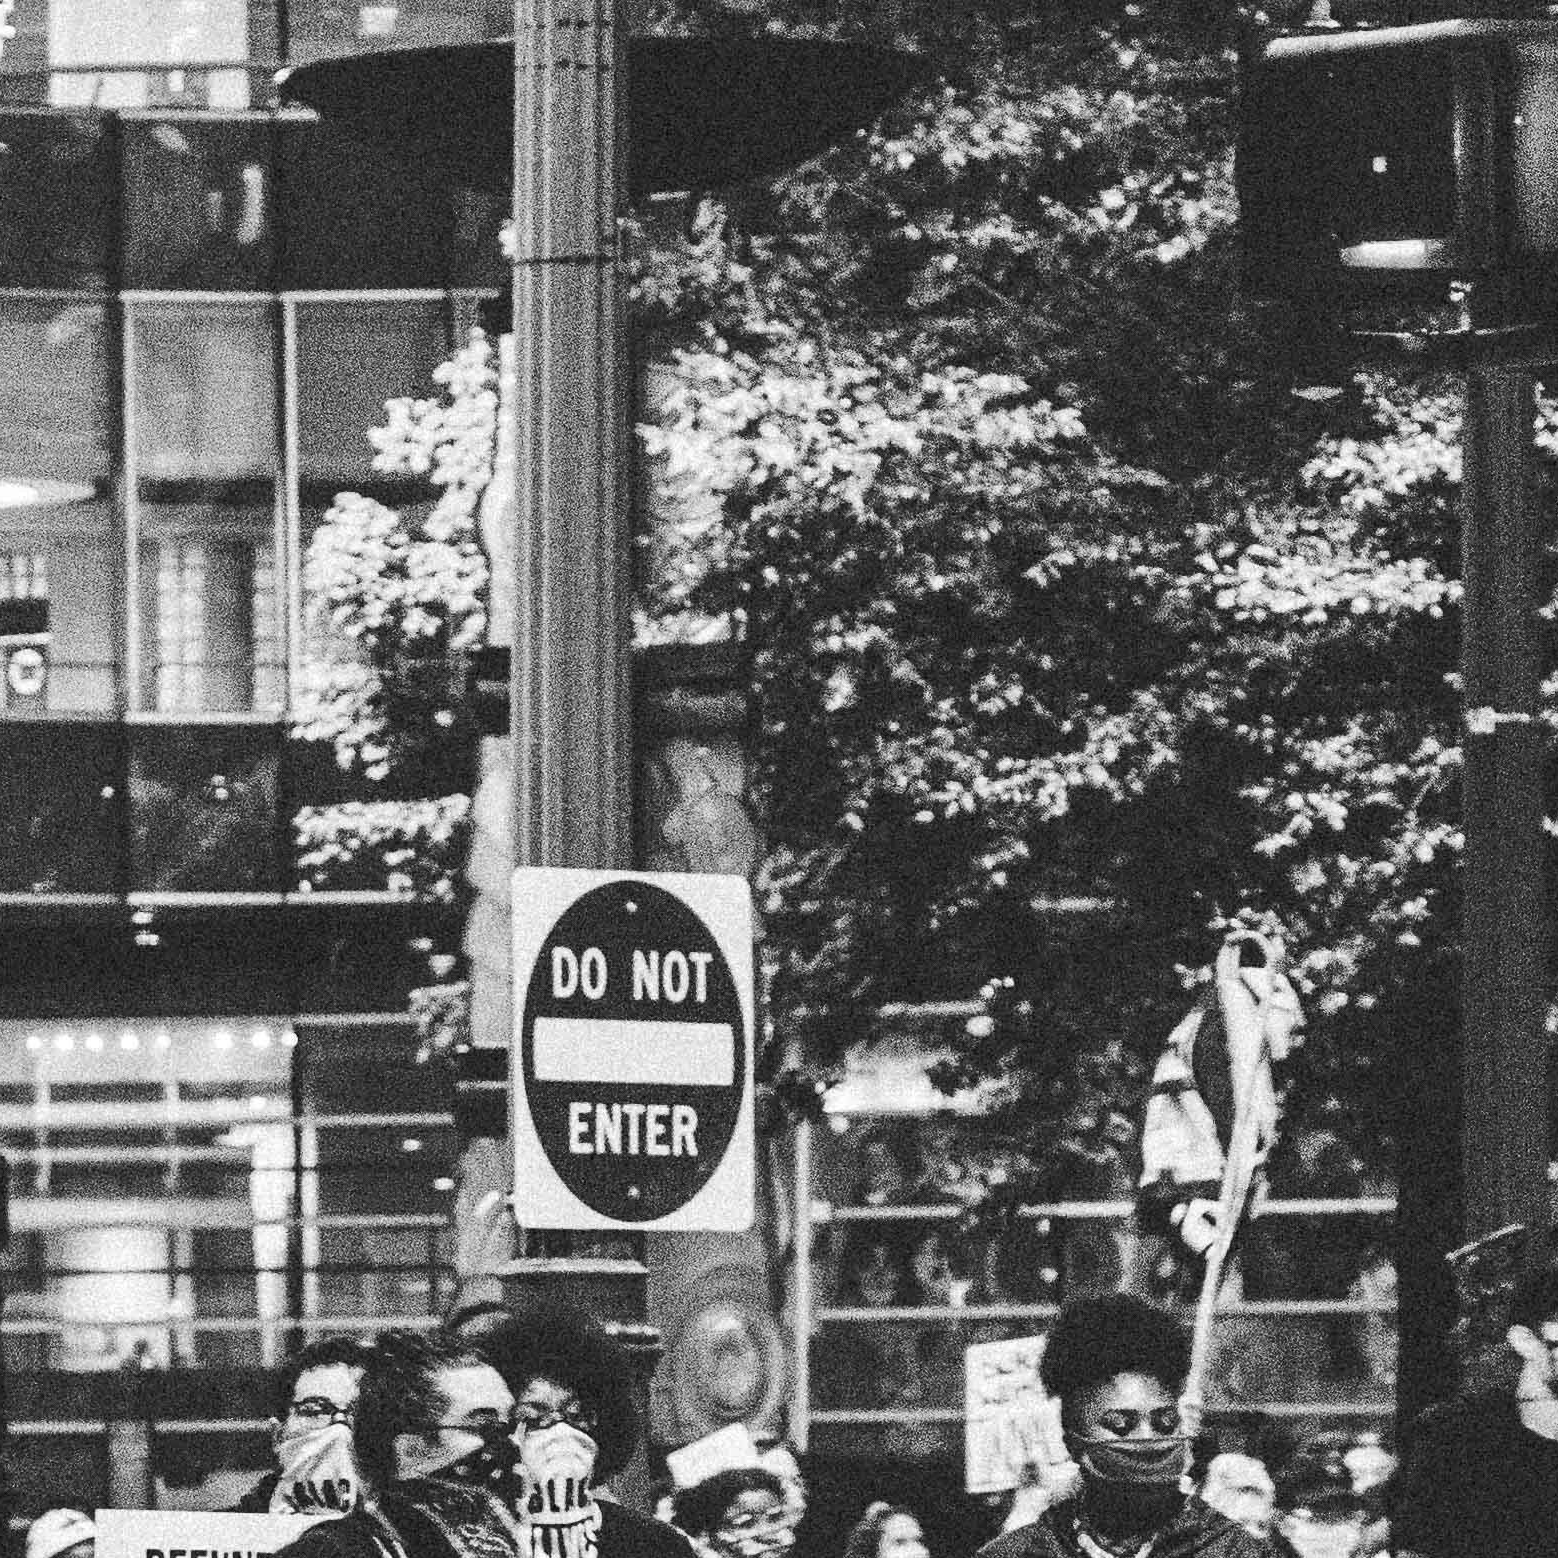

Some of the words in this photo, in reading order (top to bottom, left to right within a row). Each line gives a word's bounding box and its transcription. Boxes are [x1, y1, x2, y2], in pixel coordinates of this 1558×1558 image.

[551, 946, 608, 999] DO
[632, 949, 713, 1003] NOT
[568, 1101, 699, 1157] ENTER
